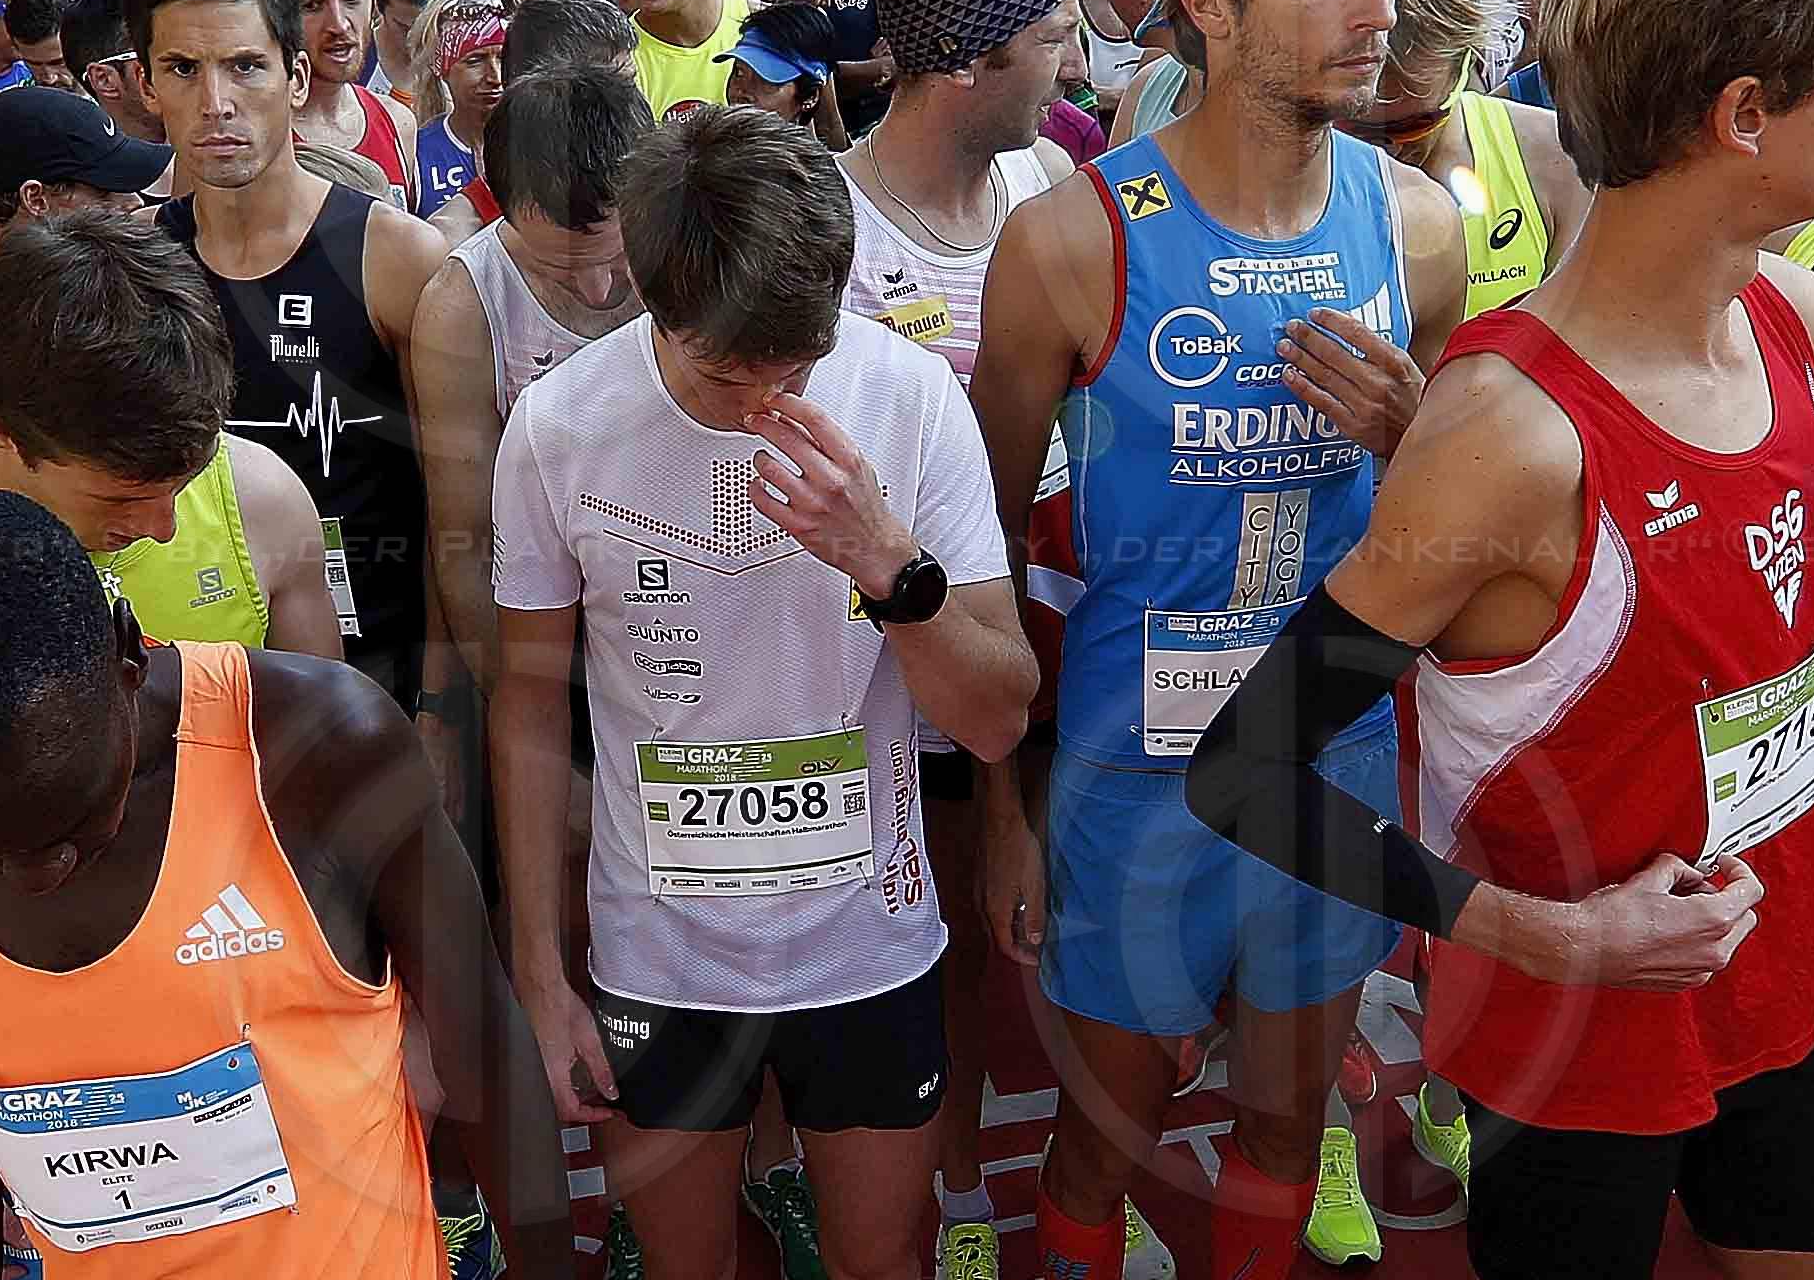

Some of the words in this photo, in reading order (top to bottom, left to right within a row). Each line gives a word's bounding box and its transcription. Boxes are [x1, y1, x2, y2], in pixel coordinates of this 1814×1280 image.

[1239, 256, 1339, 269] Autohaus
[1208, 258, 1345, 298] STACHERL
[1468, 265, 1527, 286] VILLACH
[882, 280, 918, 300] erima
[1310, 290, 1347, 300] WEIZ
[1171, 334, 1243, 356] ToBaK
[1644, 503, 1700, 537] erima
[1745, 489, 1804, 571] DSG
[1762, 539, 1806, 591] WIEN
[189, 586, 237, 609] salomon
[623, 592, 690, 604] salomon
[627, 624, 699, 643] SUUNTO
[1200, 615, 1253, 632] GRAZ
[1187, 632, 1238, 641] MARATHON
[1153, 671, 1243, 690] SCHLA
[1760, 670, 1808, 708] GRAZ
[687, 747, 743, 764] GRAZ
[675, 765, 728, 775] MARATHON
[714, 774, 737, 783] 2018
[678, 782, 829, 827] 27058
[666, 828, 727, 839] Österreichische
[728, 827, 789, 838] Meisterschaften
[791, 820, 848, 835] Halbmarathon
[174, 928, 285, 966] adidas
[5, 1088, 83, 1111] GRAZ
[47, 1119, 78, 1130] 2018
[45, 1142, 179, 1178] KIRWA
[102, 1174, 136, 1186] ELITE
[114, 1190, 132, 1210] 1
